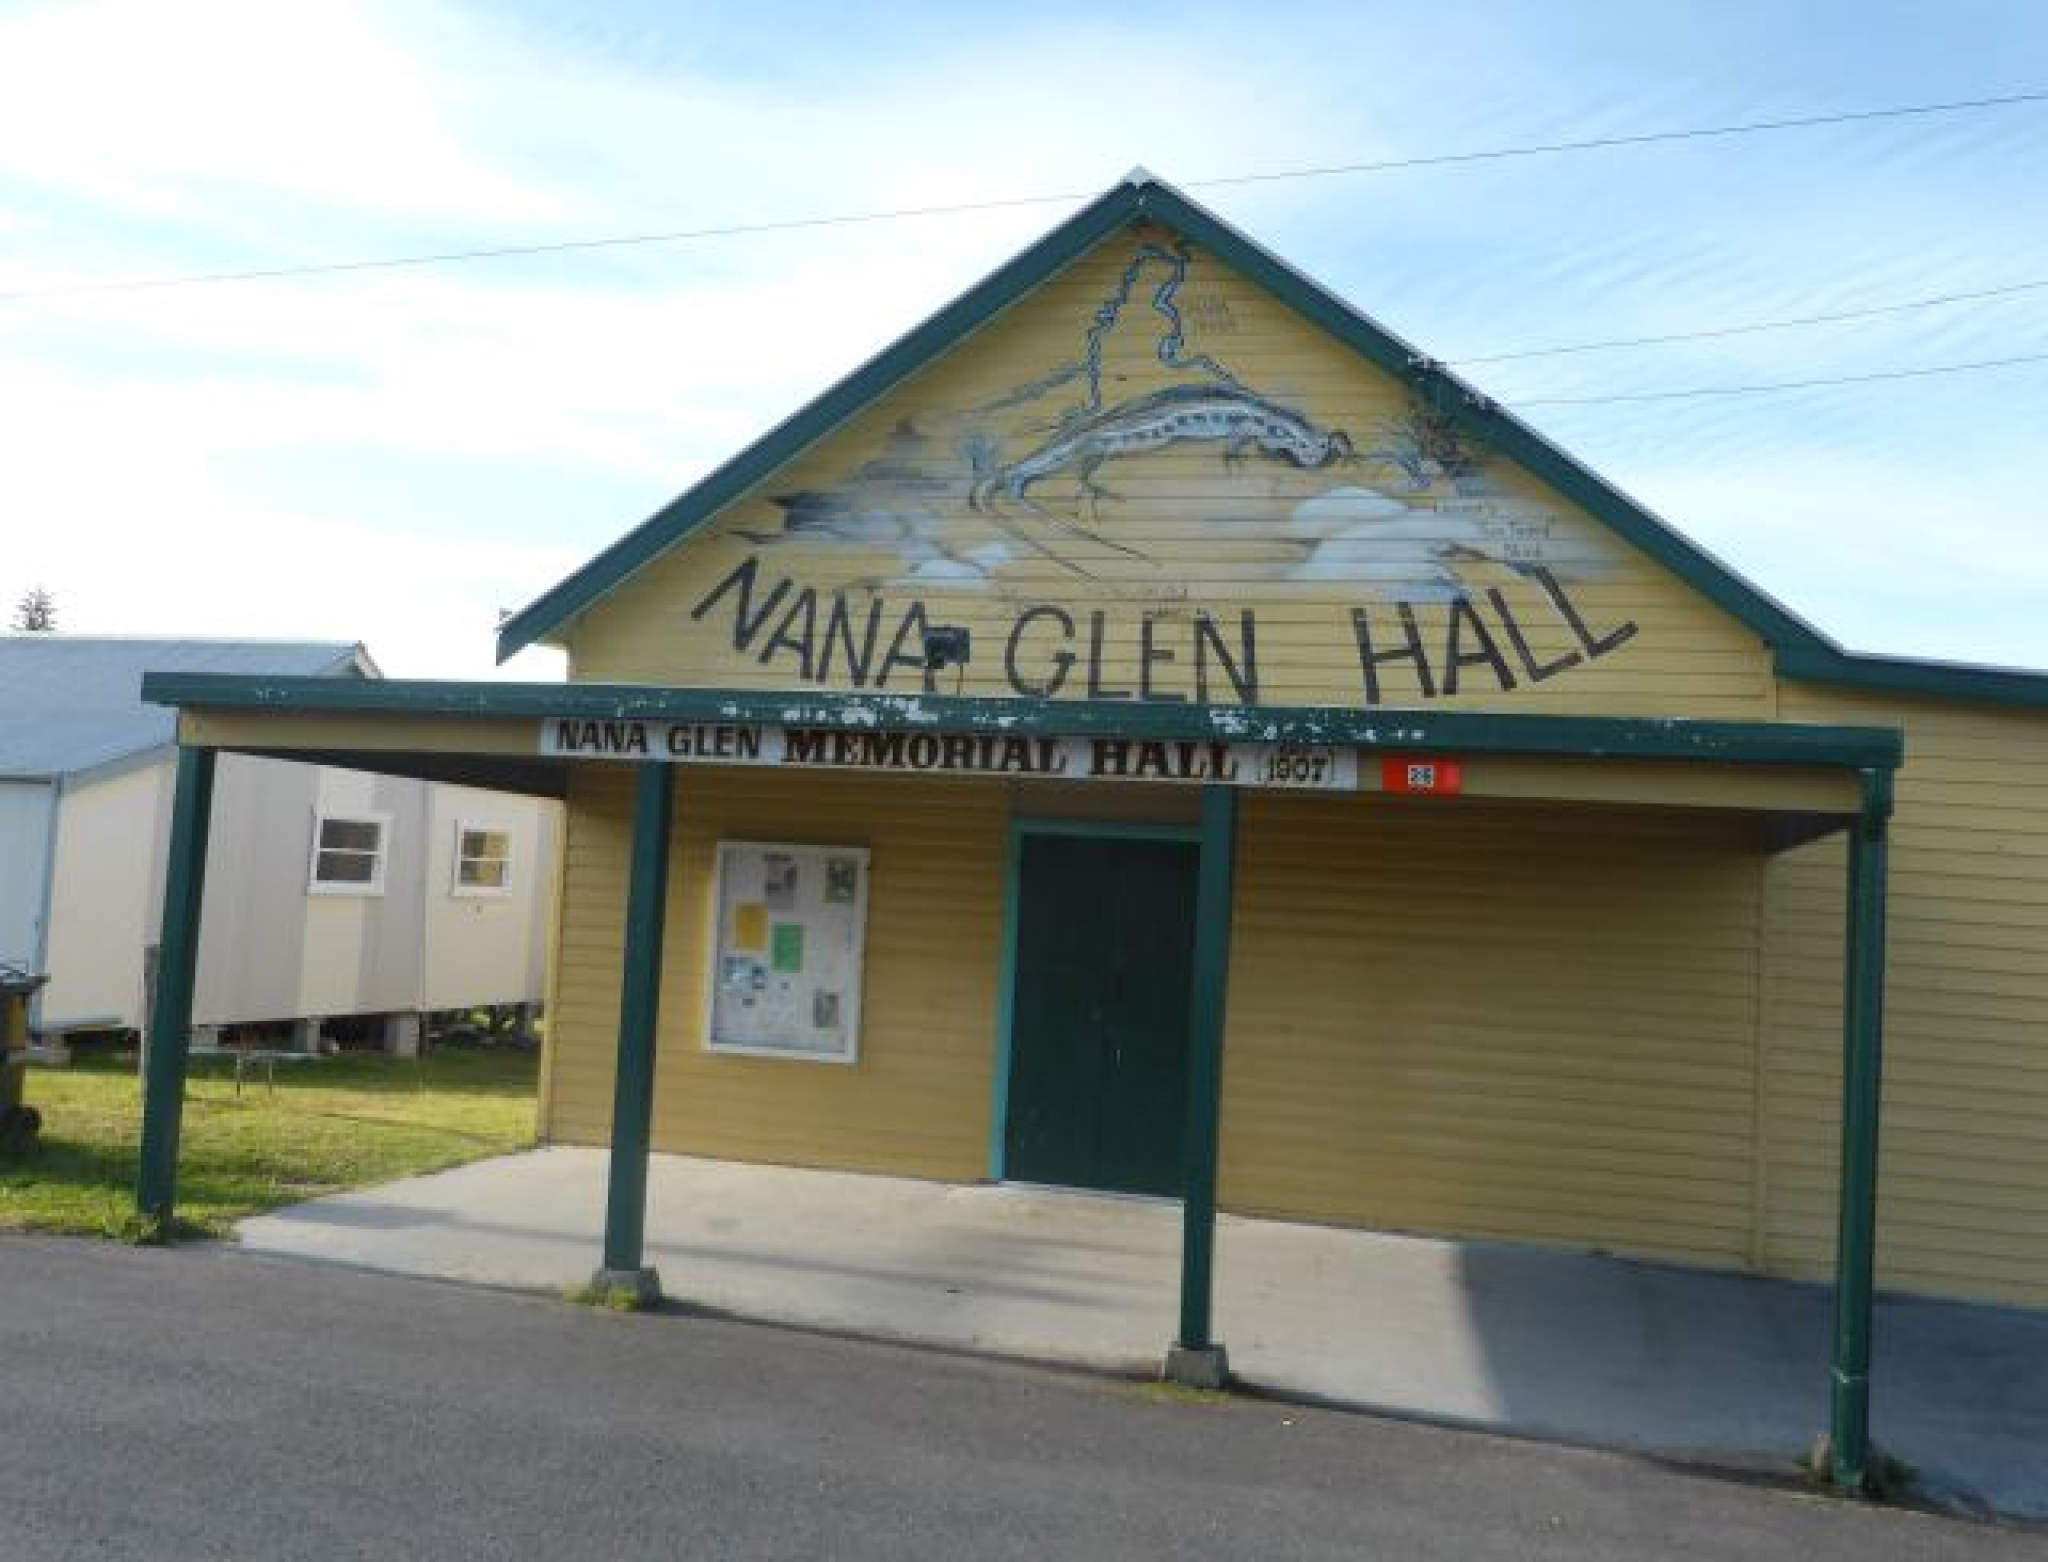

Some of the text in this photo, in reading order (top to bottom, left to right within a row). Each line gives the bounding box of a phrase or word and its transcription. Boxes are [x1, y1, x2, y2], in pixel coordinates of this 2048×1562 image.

[690, 555, 1638, 704] NANA GLEN HALL
[557, 719, 648, 753] NANA
[668, 726, 760, 758] GLEN
[782, 729, 1068, 774] MEMORIAL
[1088, 738, 1239, 779] HALL
